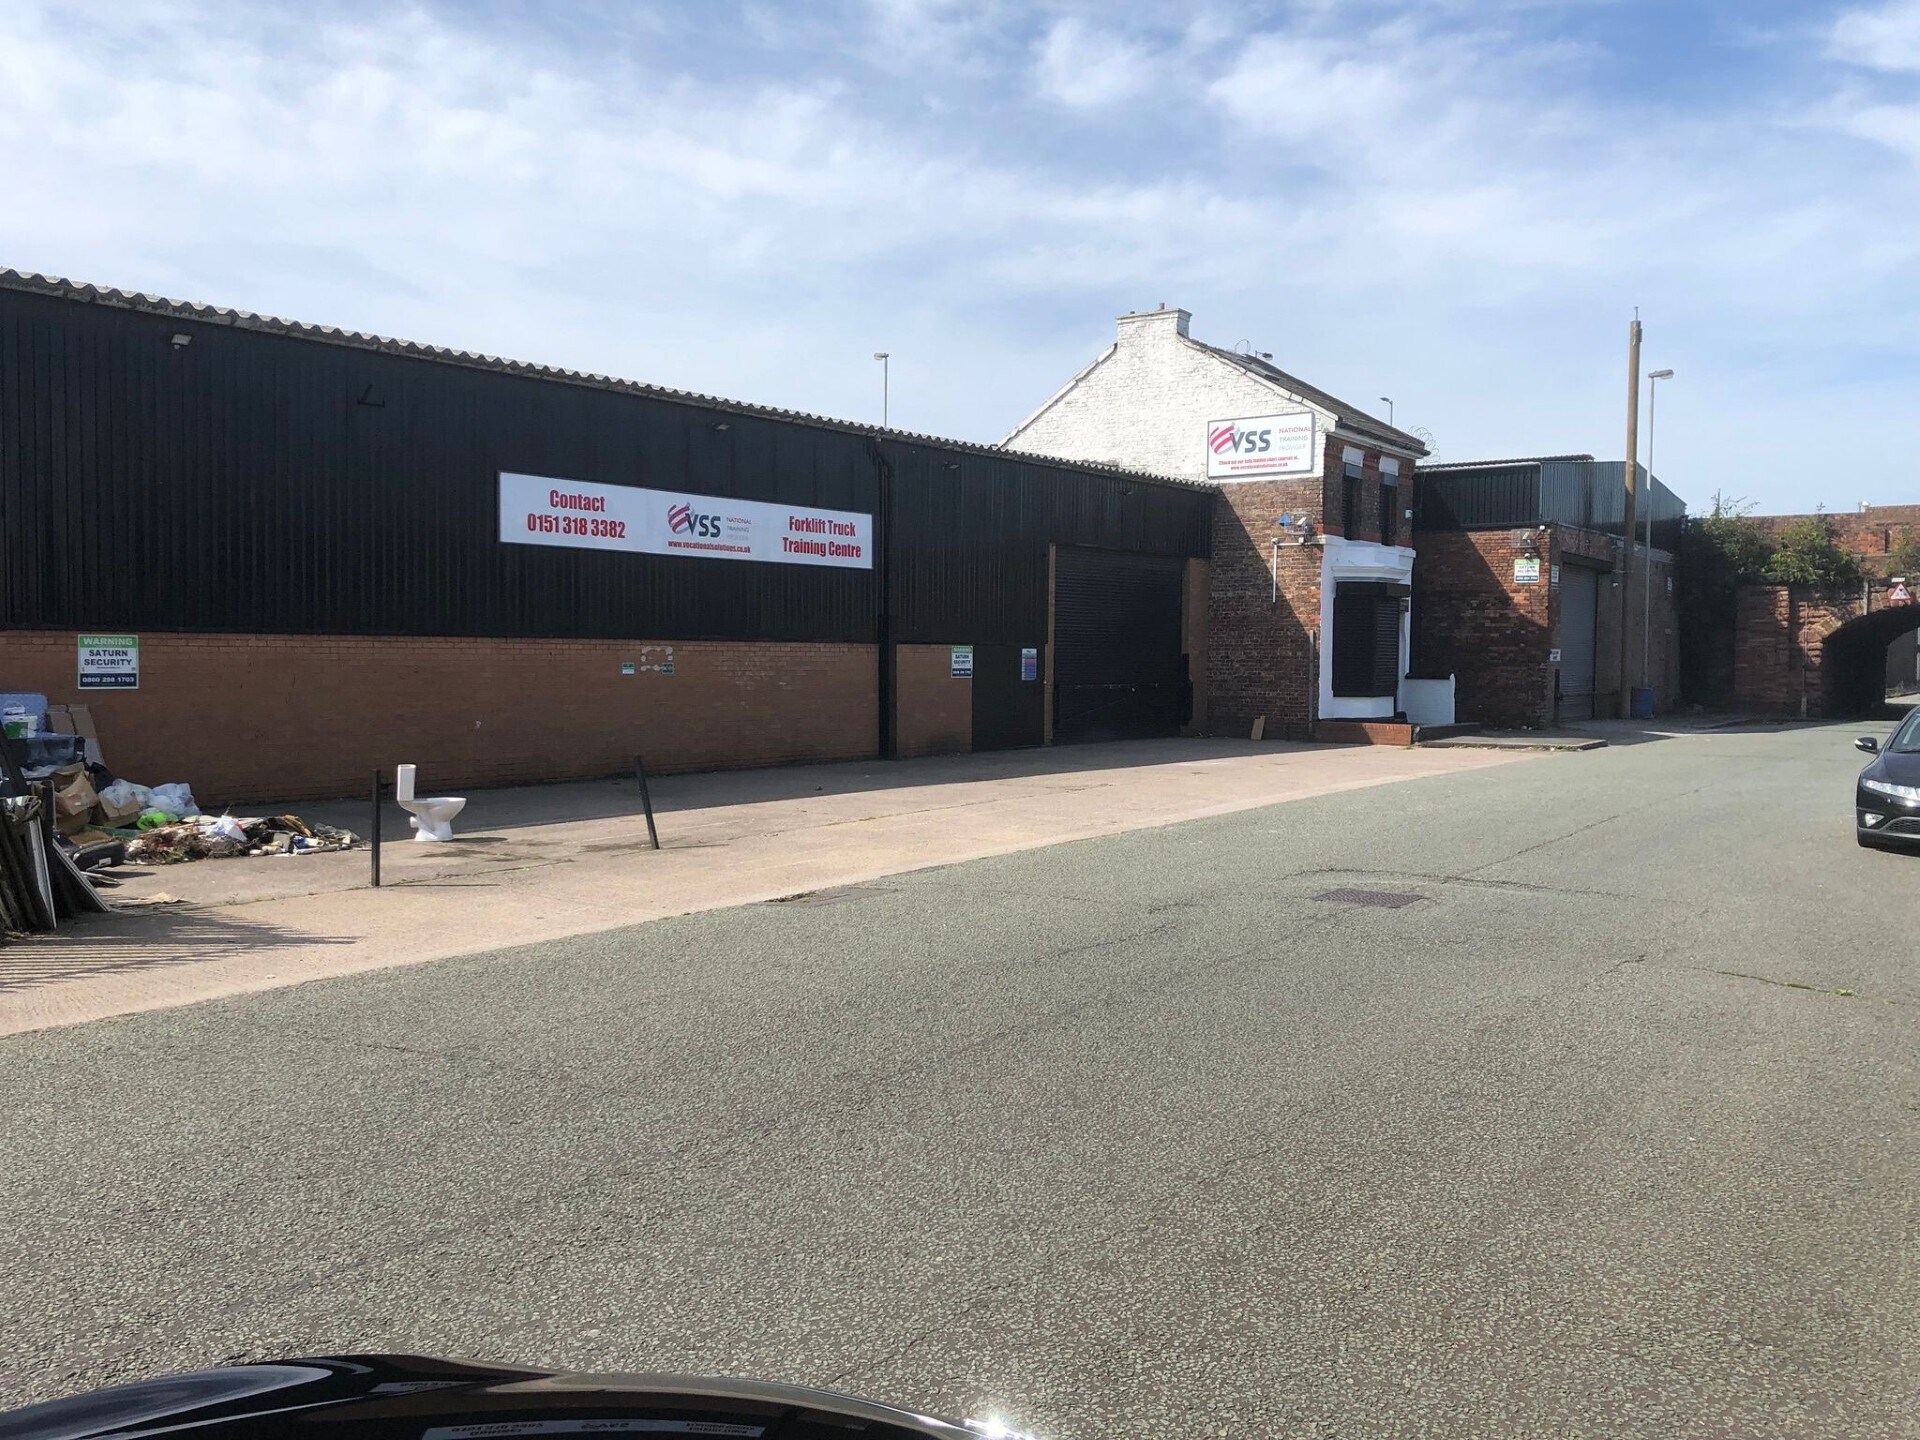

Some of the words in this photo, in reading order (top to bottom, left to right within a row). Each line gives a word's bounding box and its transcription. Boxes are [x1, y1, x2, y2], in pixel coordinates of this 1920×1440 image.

[1230, 429, 1271, 453] VSS
[550, 489, 605, 512] Contact
[527, 513, 559, 533] 0151
[563, 517, 588, 536] 318
[591, 518, 626, 538] 3382
[685, 512, 721, 538] VSS
[726, 516, 752, 525] NATIONAL
[789, 515, 827, 533] Forklift
[828, 520, 856, 536] Truck
[782, 537, 826, 557] Training
[829, 541, 861, 558] Centre
